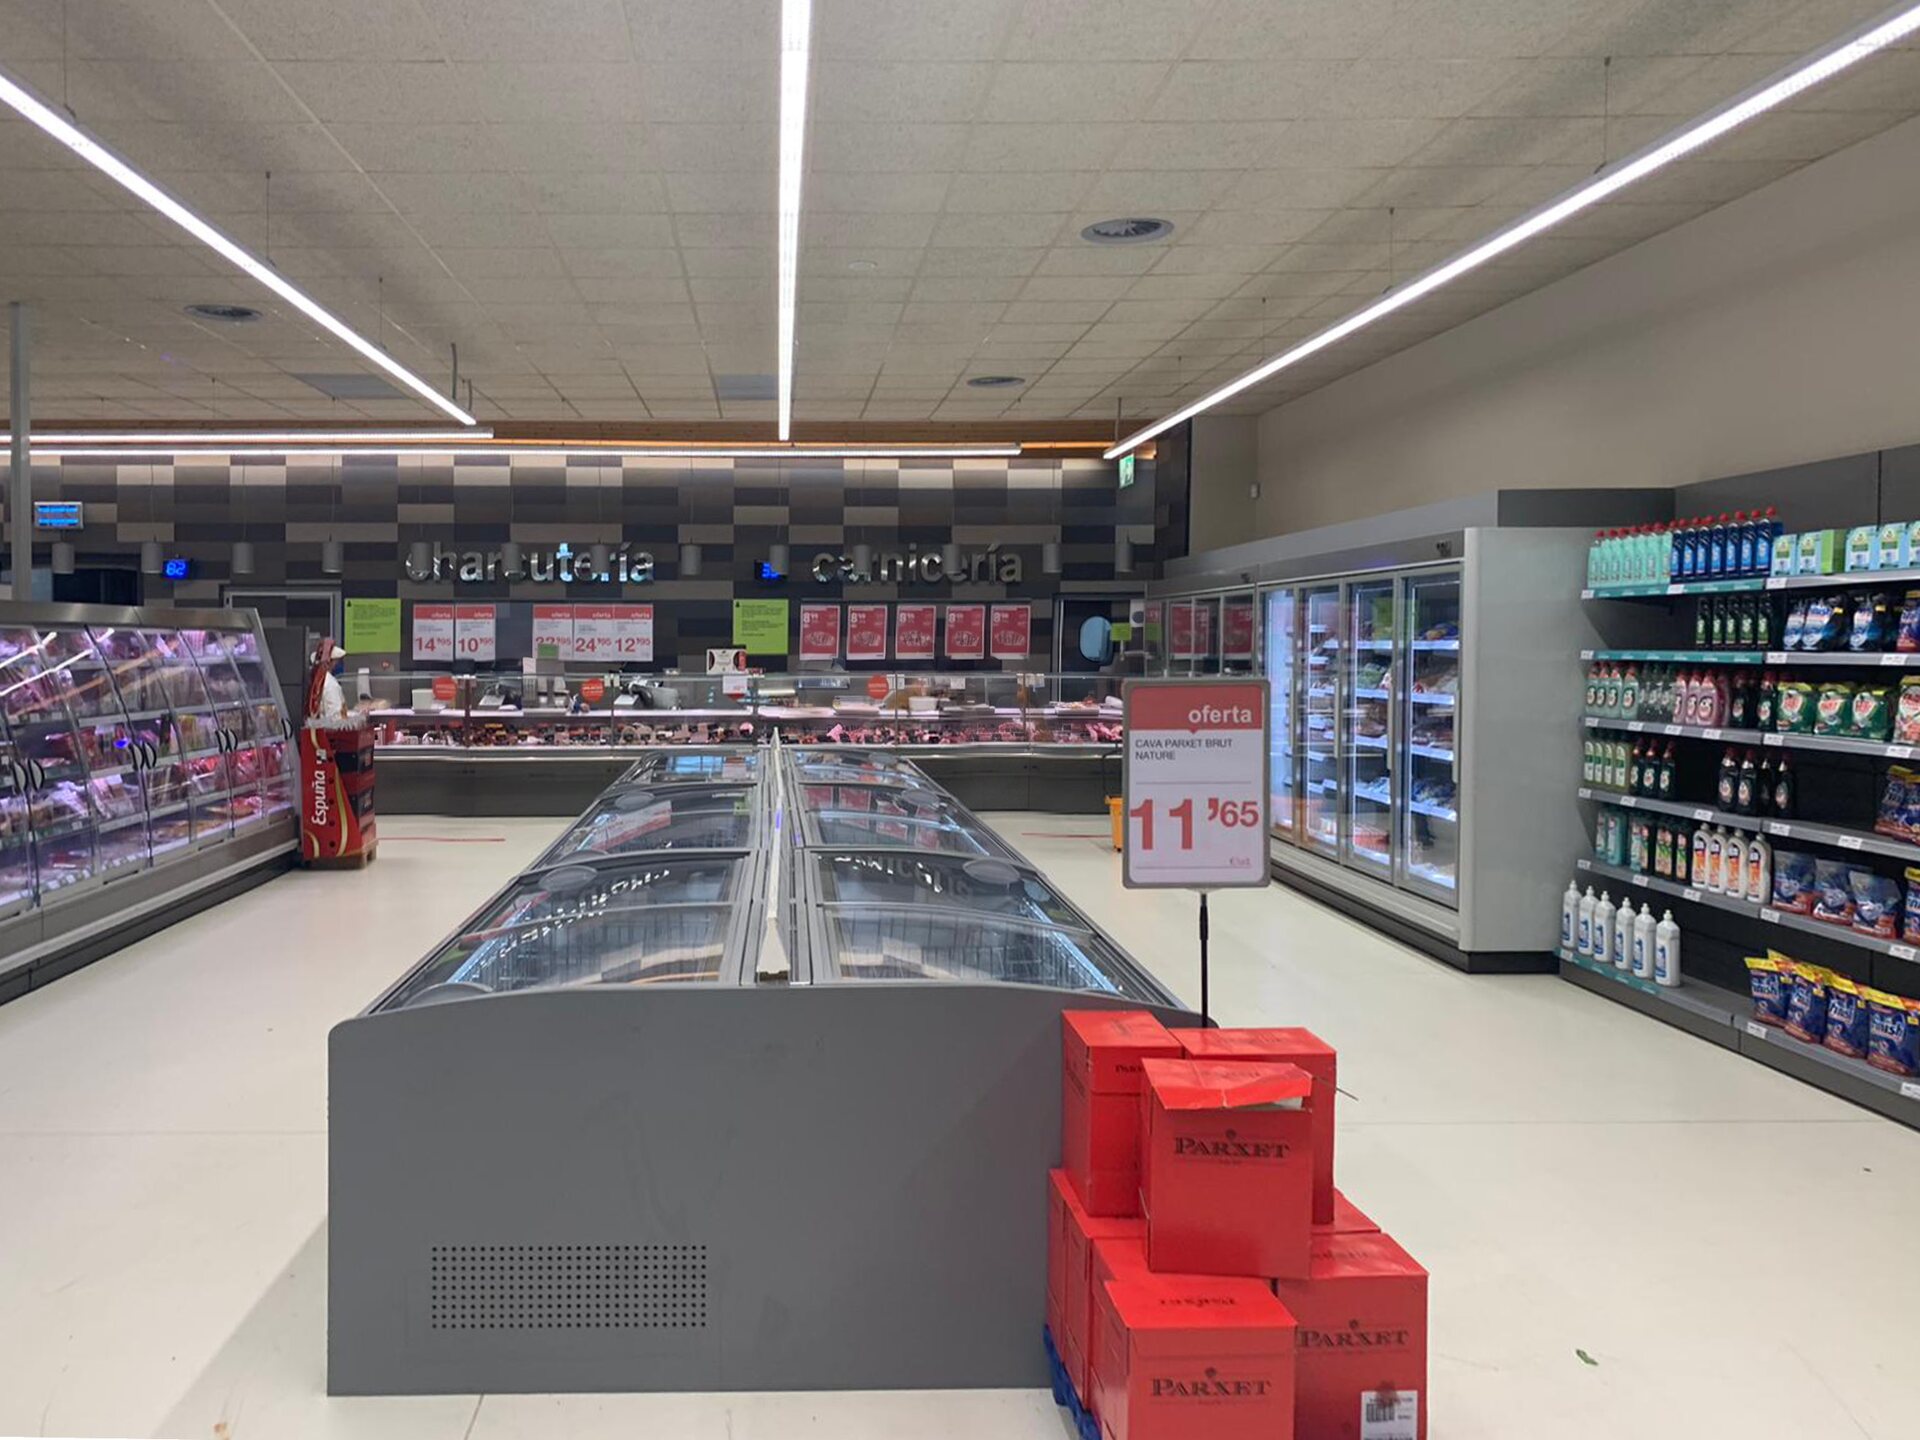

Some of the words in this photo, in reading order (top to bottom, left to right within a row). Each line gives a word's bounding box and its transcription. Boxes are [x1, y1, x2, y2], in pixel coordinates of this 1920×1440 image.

[1188, 704, 1252, 723] oferta
[1135, 738, 1162, 748] CAVA
[1205, 738, 1233, 748] BRUT
[1135, 750, 1176, 760] NATURE
[311, 770, 329, 826] Espuña
